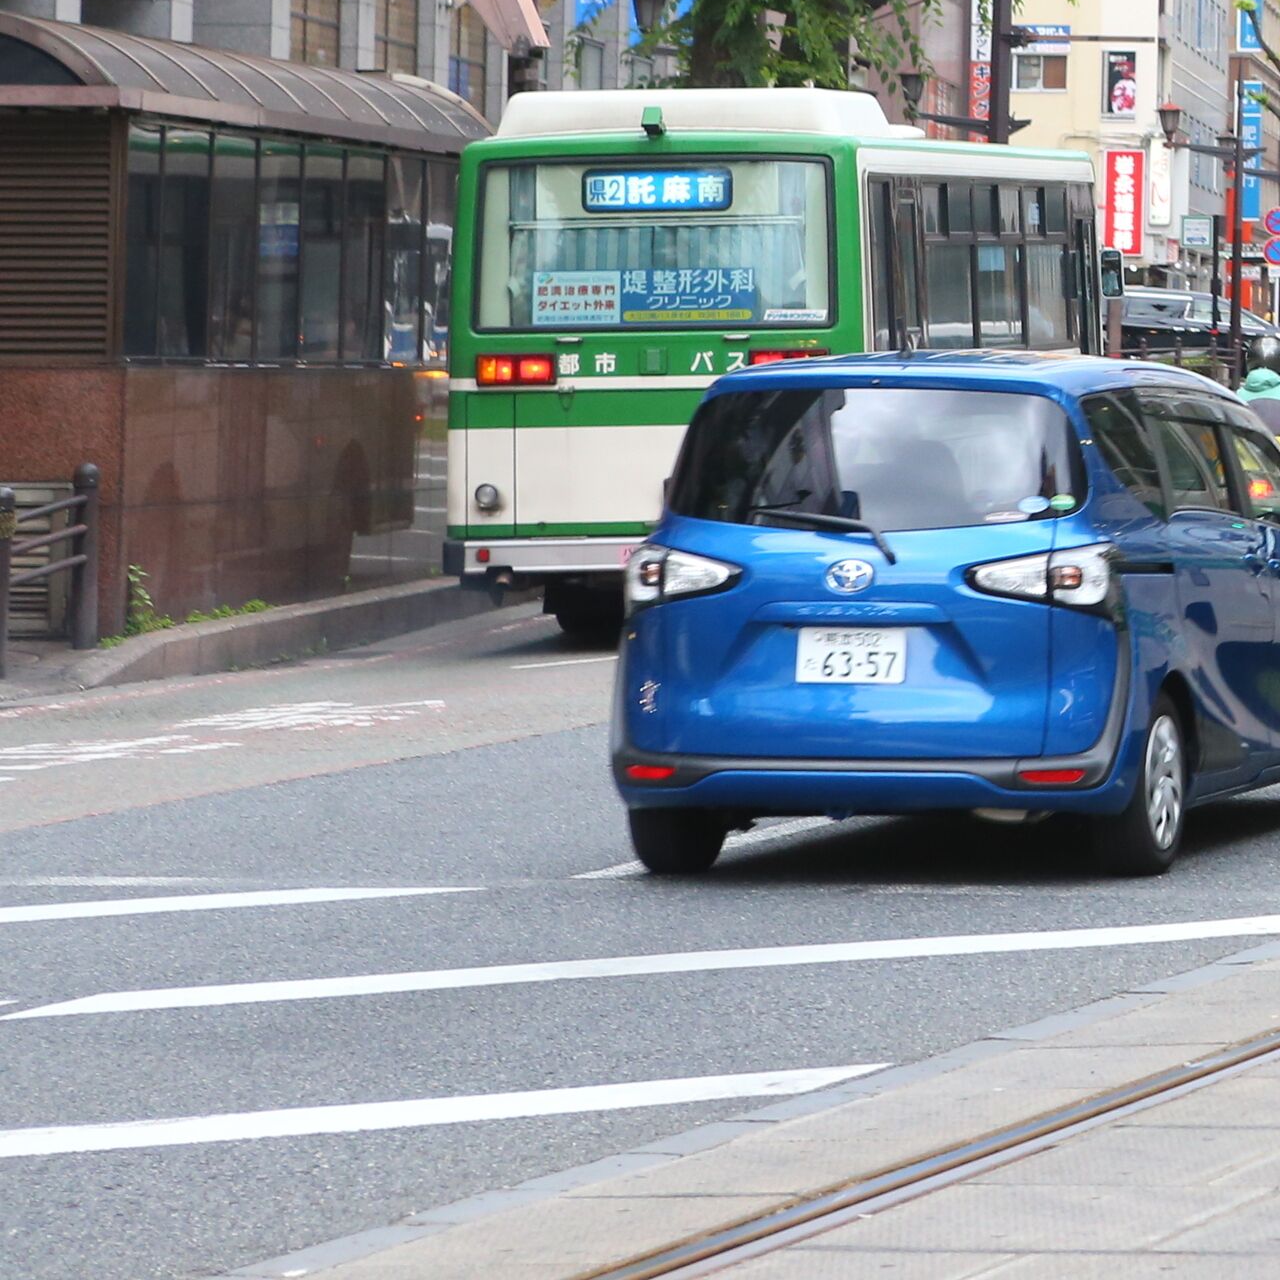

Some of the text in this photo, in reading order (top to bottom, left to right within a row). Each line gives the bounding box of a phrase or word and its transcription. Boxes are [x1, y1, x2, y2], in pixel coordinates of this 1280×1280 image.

[589, 174, 725, 205] 県2 託麻南
[646, 295, 733, 310] クリニック
[558, 350, 749, 375] 都市 バス
[822, 650, 898, 678] 63-57
